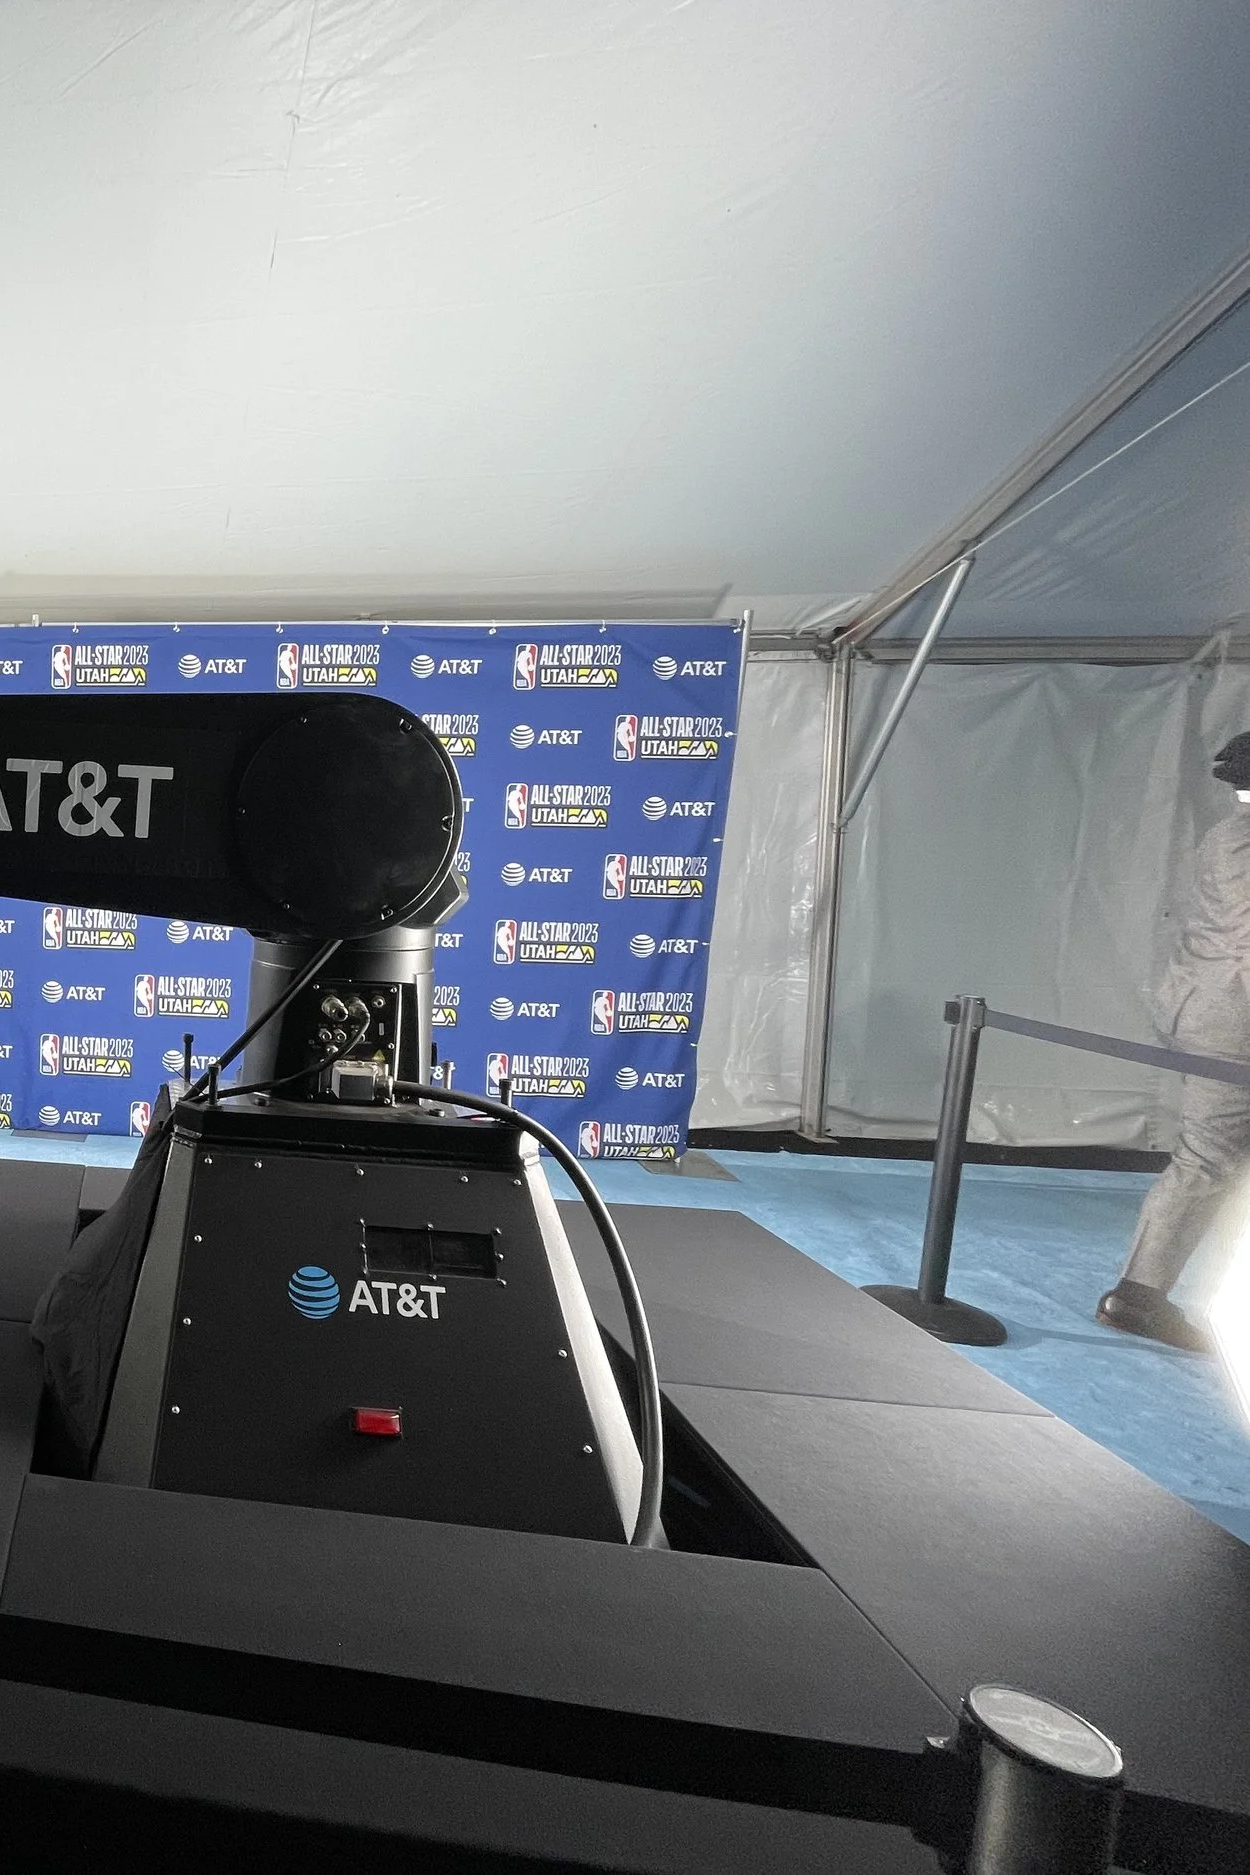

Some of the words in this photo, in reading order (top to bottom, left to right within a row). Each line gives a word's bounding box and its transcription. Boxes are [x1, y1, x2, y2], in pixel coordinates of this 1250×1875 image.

[123, 645, 149, 665] 2023
[353, 644, 380, 665] 2023
[594, 646, 622, 666] 2023
[204, 659, 247, 674] AT&T
[438, 660, 483, 674] AT&T
[681, 661, 726, 675] AT&T
[76, 668, 110, 682] UTAH
[303, 668, 338, 682] UTAH
[541, 669, 578, 683] UTAH
[452, 714, 479, 735] 2023
[695, 717, 723, 738] 2023
[538, 730, 582, 745] AT&T
[641, 740, 678, 755] UTAH
[584, 786, 612, 806] 2023
[531, 808, 568, 823] UTAH
[670, 802, 715, 817] AT&T
[455, 851, 471, 872] 23
[684, 857, 707, 877] 2023
[528, 868, 573, 883] AT&T
[630, 880, 668, 894] UTAH
[113, 911, 138, 930] 2023
[66, 931, 100, 944] UTAH
[192, 926, 233, 941] AT&T
[434, 933, 464, 948] T&T
[571, 924, 599, 943] 2023
[520, 944, 555, 959] UTAH
[658, 939, 698, 955] AT&T
[66, 986, 106, 1001] AT&T
[206, 978, 232, 998] 2023
[434, 986, 460, 1006] 2023
[666, 993, 693, 1013] 2023
[159, 998, 191, 1012] UTAH
[517, 1003, 560, 1018] AT&T
[619, 1015, 648, 1029] UTAH
[110, 1039, 134, 1058] 2023
[63, 1058, 97, 1072] UTAH
[562, 1058, 589, 1078] 2023
[512, 1079, 549, 1093] UTAH
[642, 1073, 685, 1088] AT&T
[63, 1111, 102, 1126] AT&T
[655, 1124, 680, 1144] 2023
[604, 1146, 639, 1158] UTAH
[349, 1280, 446, 1319] AT&T
